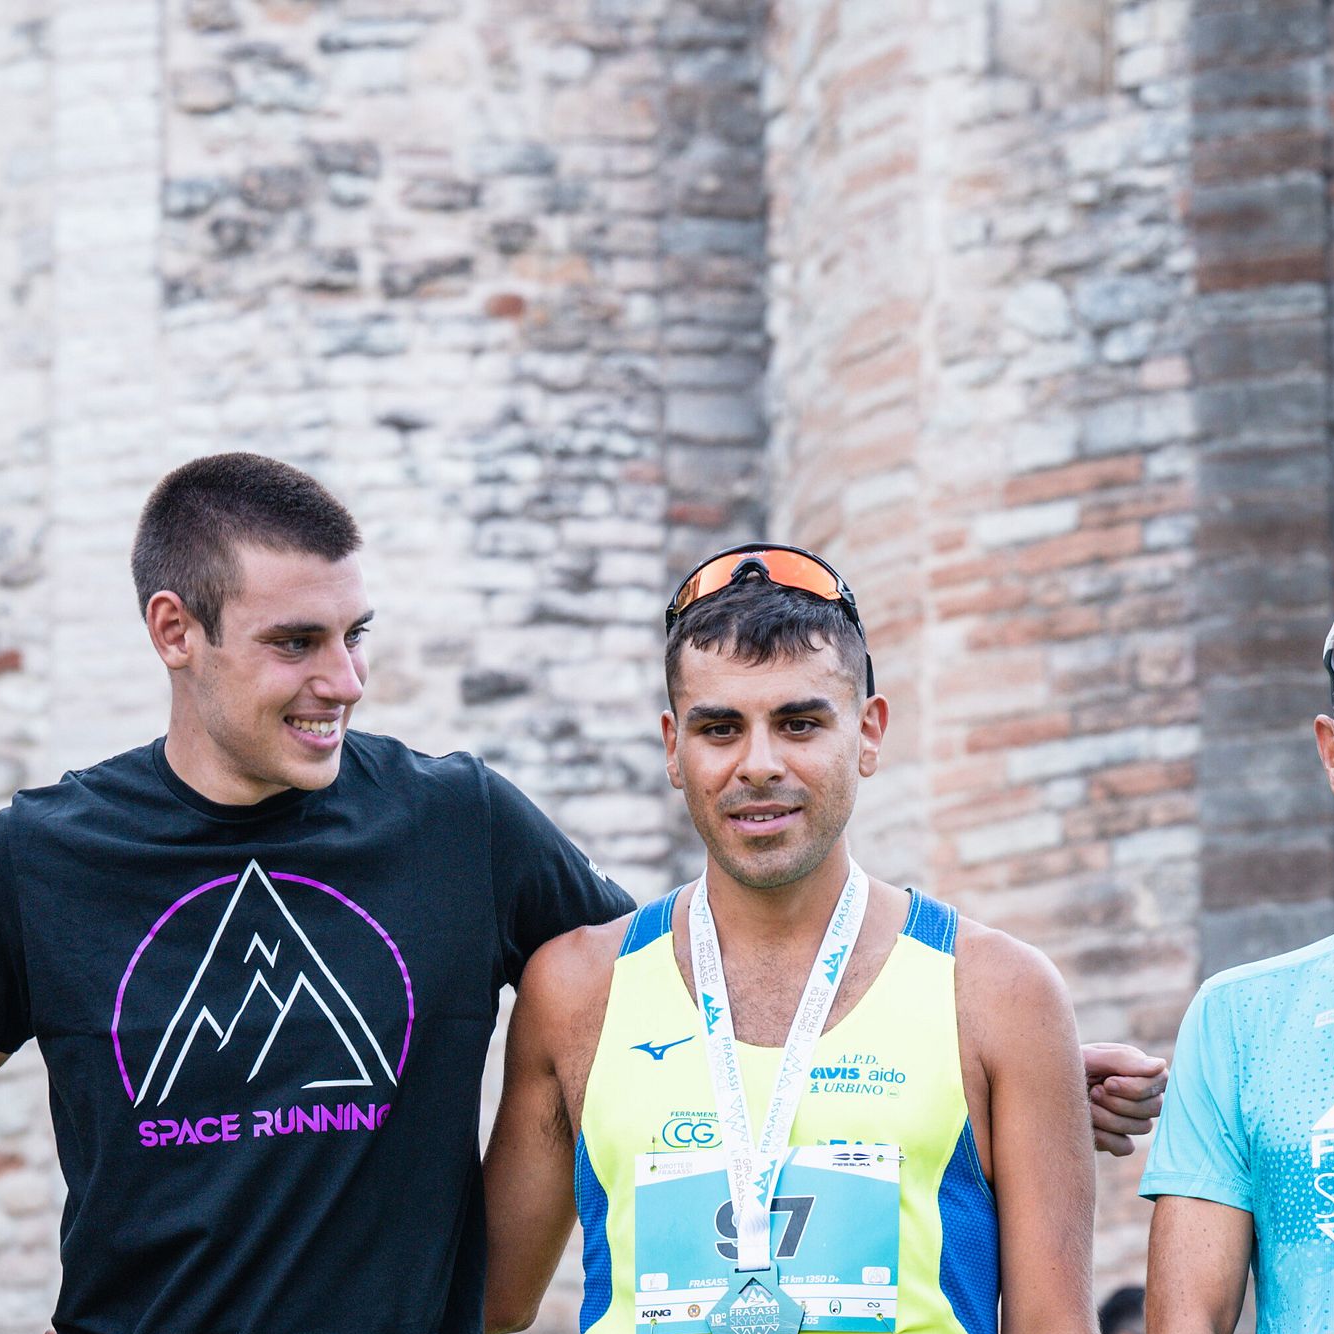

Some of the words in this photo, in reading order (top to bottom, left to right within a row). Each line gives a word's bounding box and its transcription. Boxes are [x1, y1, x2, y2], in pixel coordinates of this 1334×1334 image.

[832, 882, 857, 936] FRASASSI
[696, 941, 707, 987] FRASASSI
[705, 937, 717, 972] GROTTE
[797, 998, 818, 1033] GROTTE
[806, 987, 831, 1039] FRASASSI
[722, 1036, 739, 1091] FRASASSI
[810, 1067, 860, 1080] AVIS
[868, 1067, 906, 1084] aido
[838, 1054, 879, 1065] A.P.D.
[824, 1082, 884, 1096] URBINO
[138, 1113, 241, 1148] SPACE
[253, 1102, 391, 1138] RUNNING
[670, 1111, 718, 1119] FERRAMENT
[760, 1097, 783, 1154] FRASASSI
[715, 1195, 816, 1261] 97
[689, 1277, 728, 1289] FRASASS
[642, 1309, 671, 1318] KING
[730, 1306, 779, 1317] FRASASSI
[730, 1314, 779, 1327] SKYRACE
